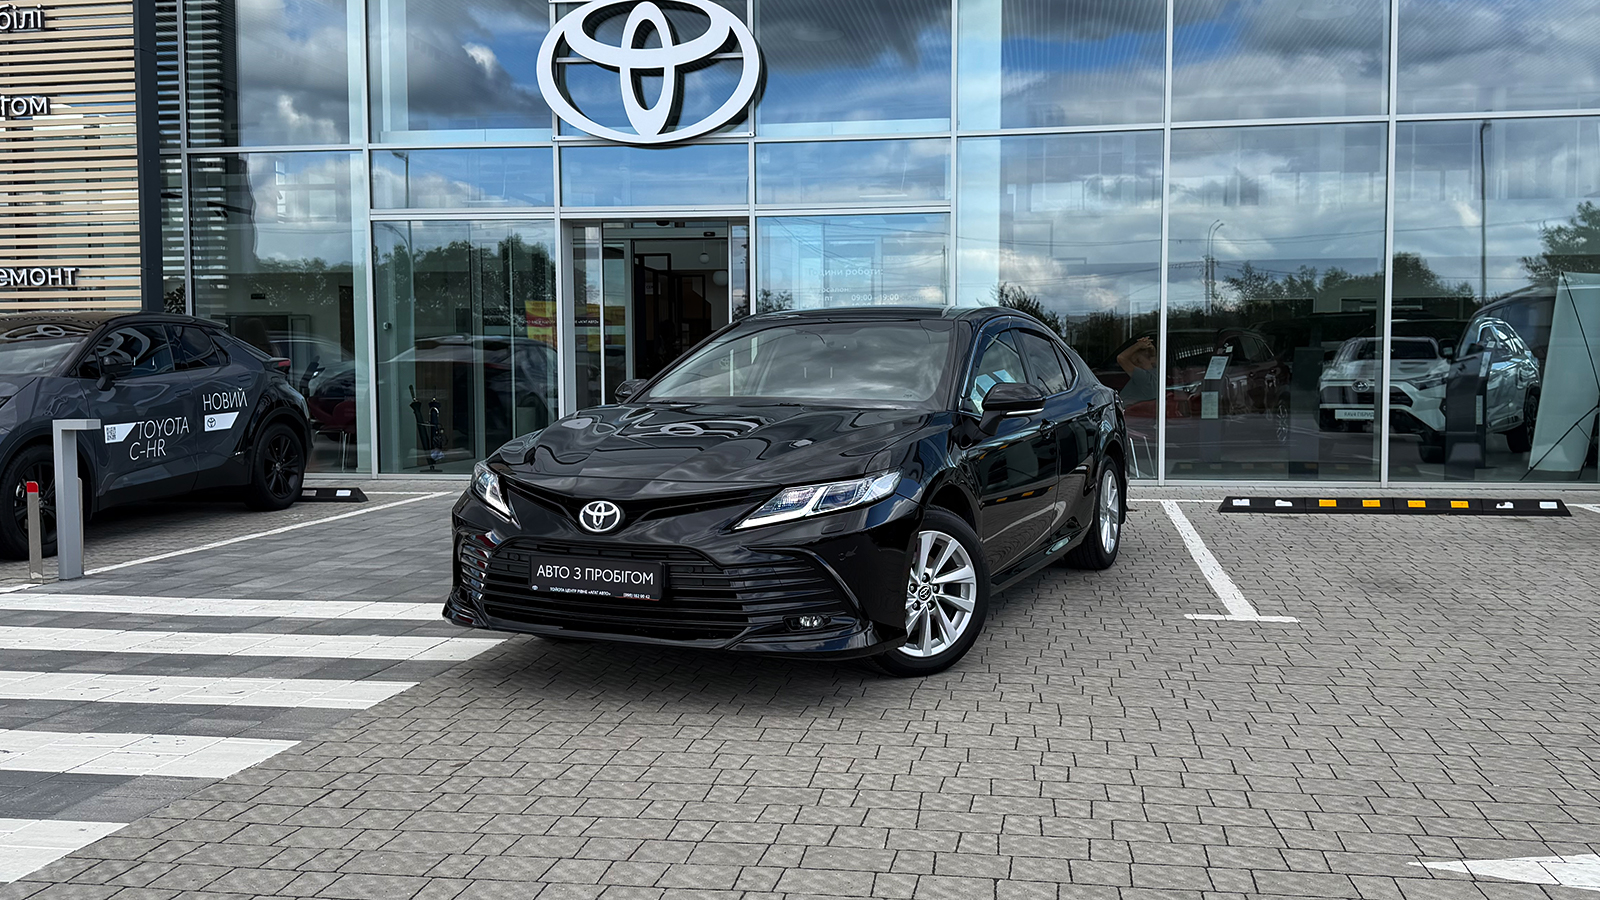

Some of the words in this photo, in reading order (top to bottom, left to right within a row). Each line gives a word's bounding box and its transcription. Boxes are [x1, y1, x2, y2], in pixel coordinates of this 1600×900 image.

[845, 266, 884, 277] роботи:
[851, 293, 873, 301] 09:00
[202, 387, 248, 411] НОВИЙ
[137, 416, 190, 440] TOYOTA
[129, 438, 167, 461] C-HR
[536, 564, 570, 579] АВТО
[585, 567, 654, 585] ПРОБІГОМ
